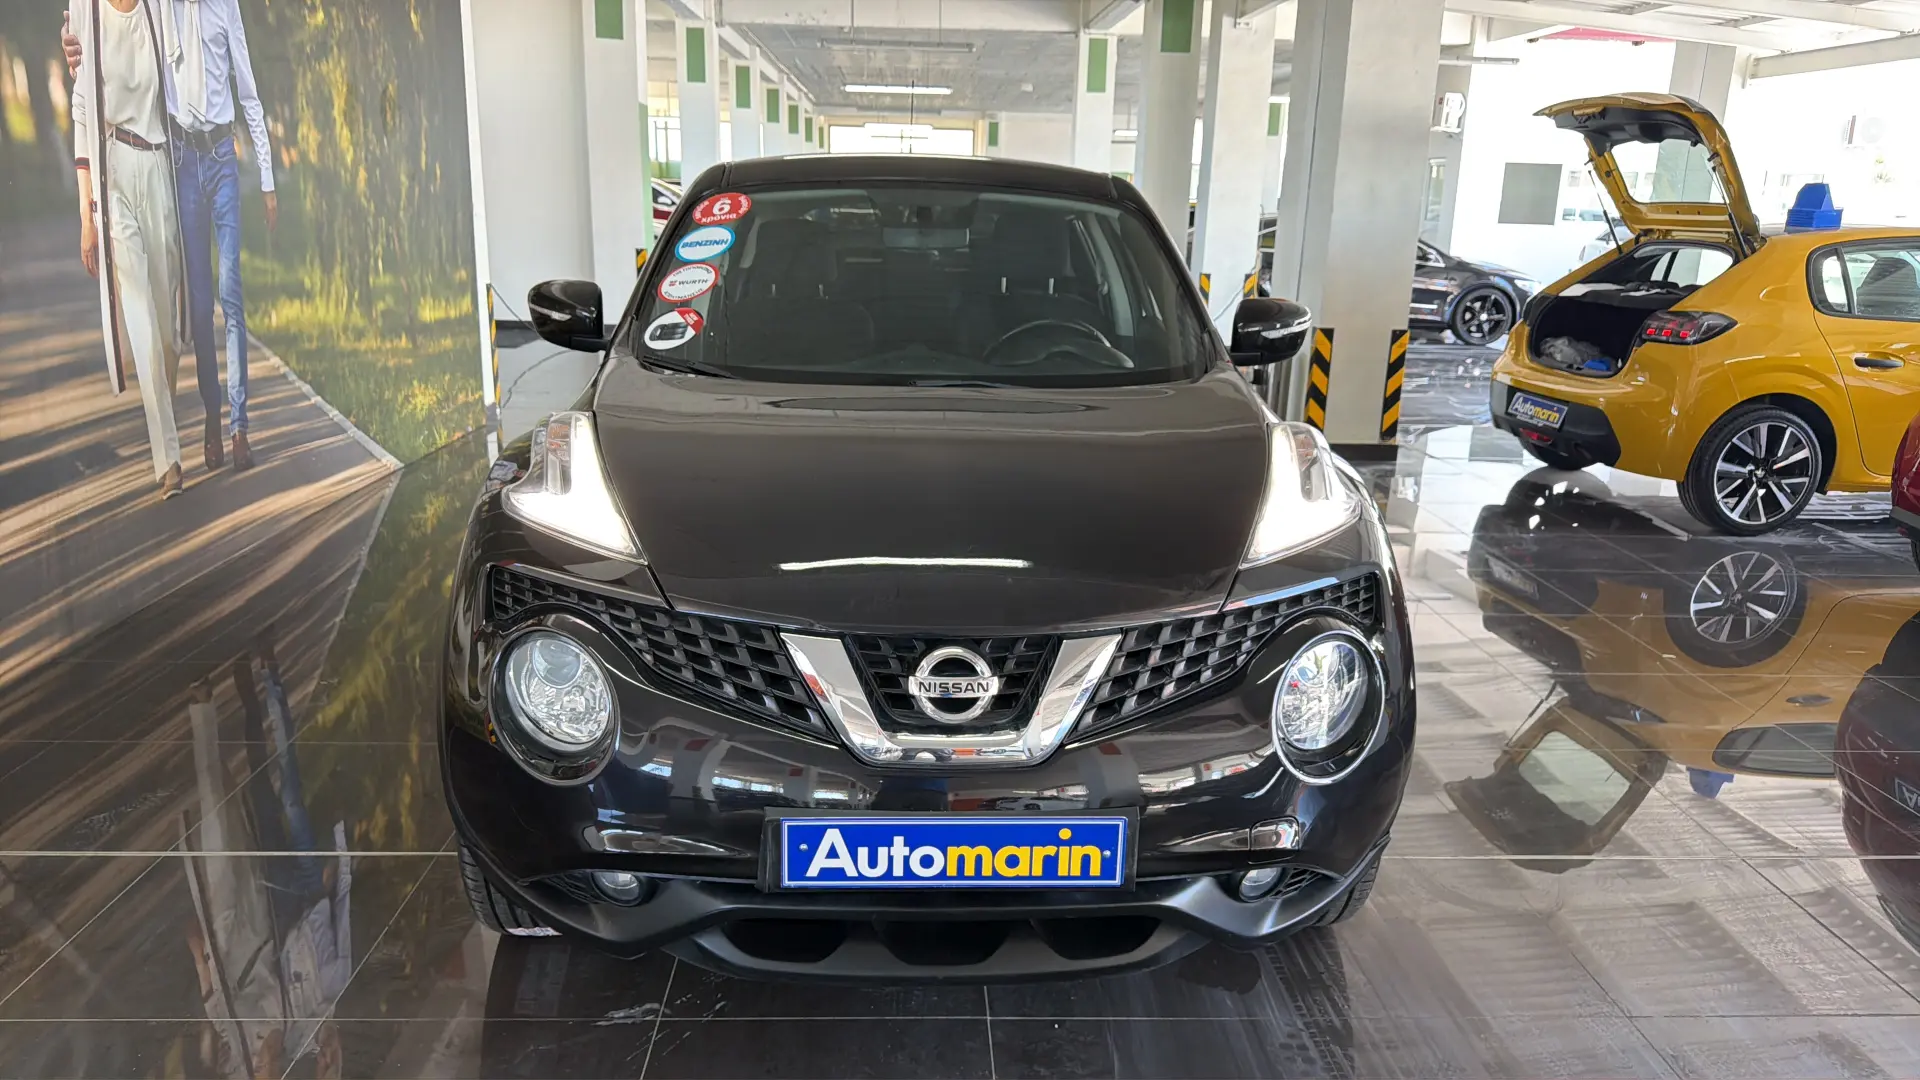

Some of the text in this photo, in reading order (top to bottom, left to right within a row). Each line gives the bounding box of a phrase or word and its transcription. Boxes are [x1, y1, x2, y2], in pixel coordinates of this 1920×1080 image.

[713, 200, 732, 215] 6
[1513, 396, 1560, 423] Automarin
[919, 681, 989, 693] NISSAN
[804, 828, 1102, 878] Automarin
